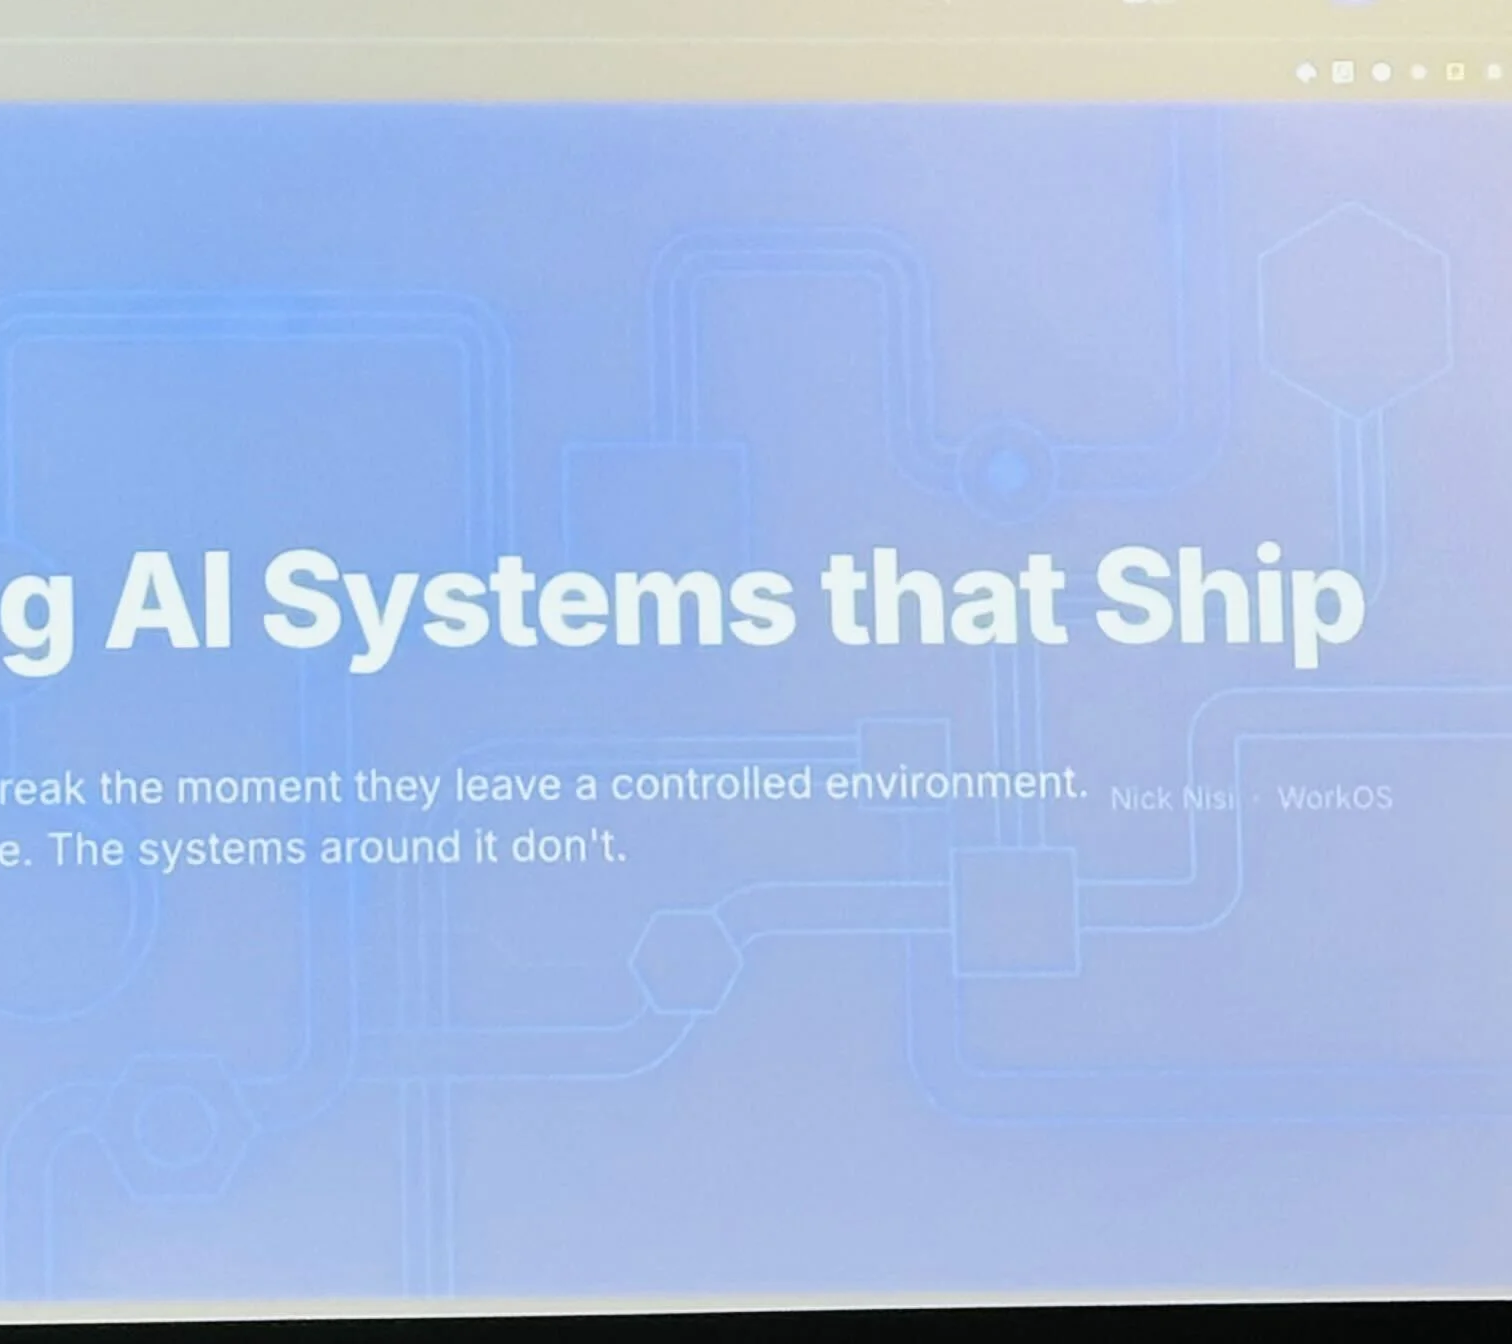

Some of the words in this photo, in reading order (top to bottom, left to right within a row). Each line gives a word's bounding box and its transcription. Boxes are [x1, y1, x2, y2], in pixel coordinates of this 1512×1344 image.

[107, 551, 230, 648] AI
[264, 550, 795, 673] Systems
[821, 548, 1068, 645] that
[1096, 541, 1365, 669] Ship
[100, 770, 163, 805] the
[178, 770, 342, 804] moment
[354, 768, 441, 811] they
[456, 767, 561, 802] leave
[575, 774, 597, 801] a
[612, 765, 811, 800] controlled
[826, 764, 1088, 799] environment.
[1111, 785, 1173, 811] Nick
[1182, 785, 1235, 811] Nisi
[1277, 784, 1393, 811] WorkOS
[47, 831, 124, 866] The
[139, 833, 306, 874] systems
[320, 829, 460, 864] around
[476, 828, 498, 863] it
[512, 827, 626, 862] don't.
